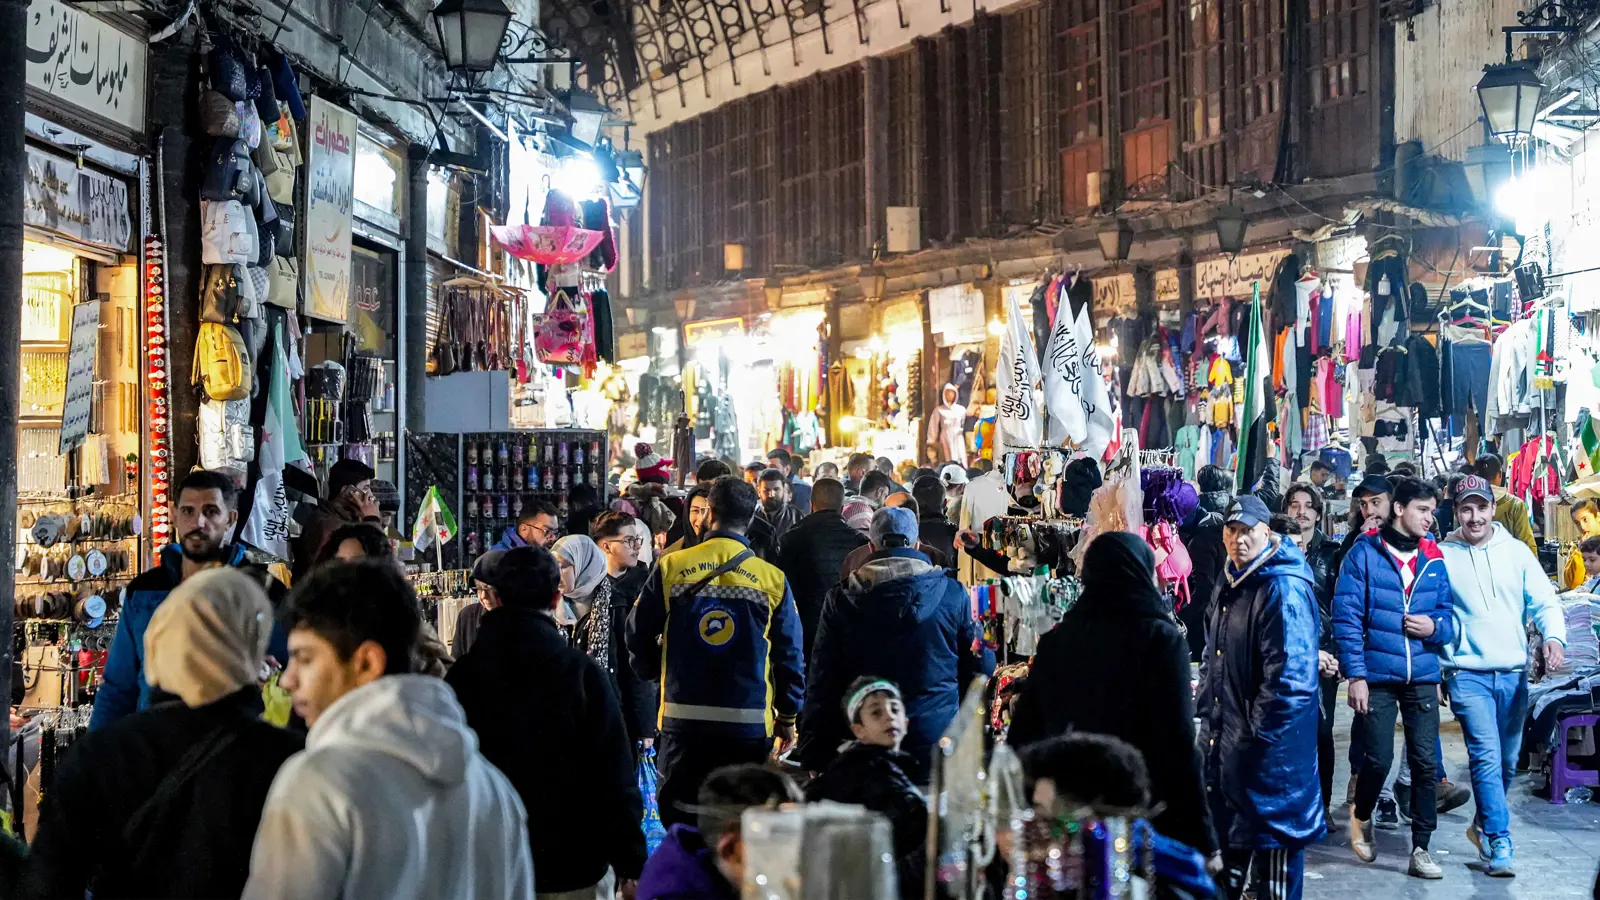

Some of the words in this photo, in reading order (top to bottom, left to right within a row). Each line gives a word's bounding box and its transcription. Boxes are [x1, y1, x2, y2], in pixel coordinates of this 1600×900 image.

[26, 5, 79, 93] الشريف
[70, 27, 128, 110] ملبوسات
[315, 111, 350, 157] عطورات
[1457, 474, 1487, 493] BOY
[680, 566, 697, 578] The
